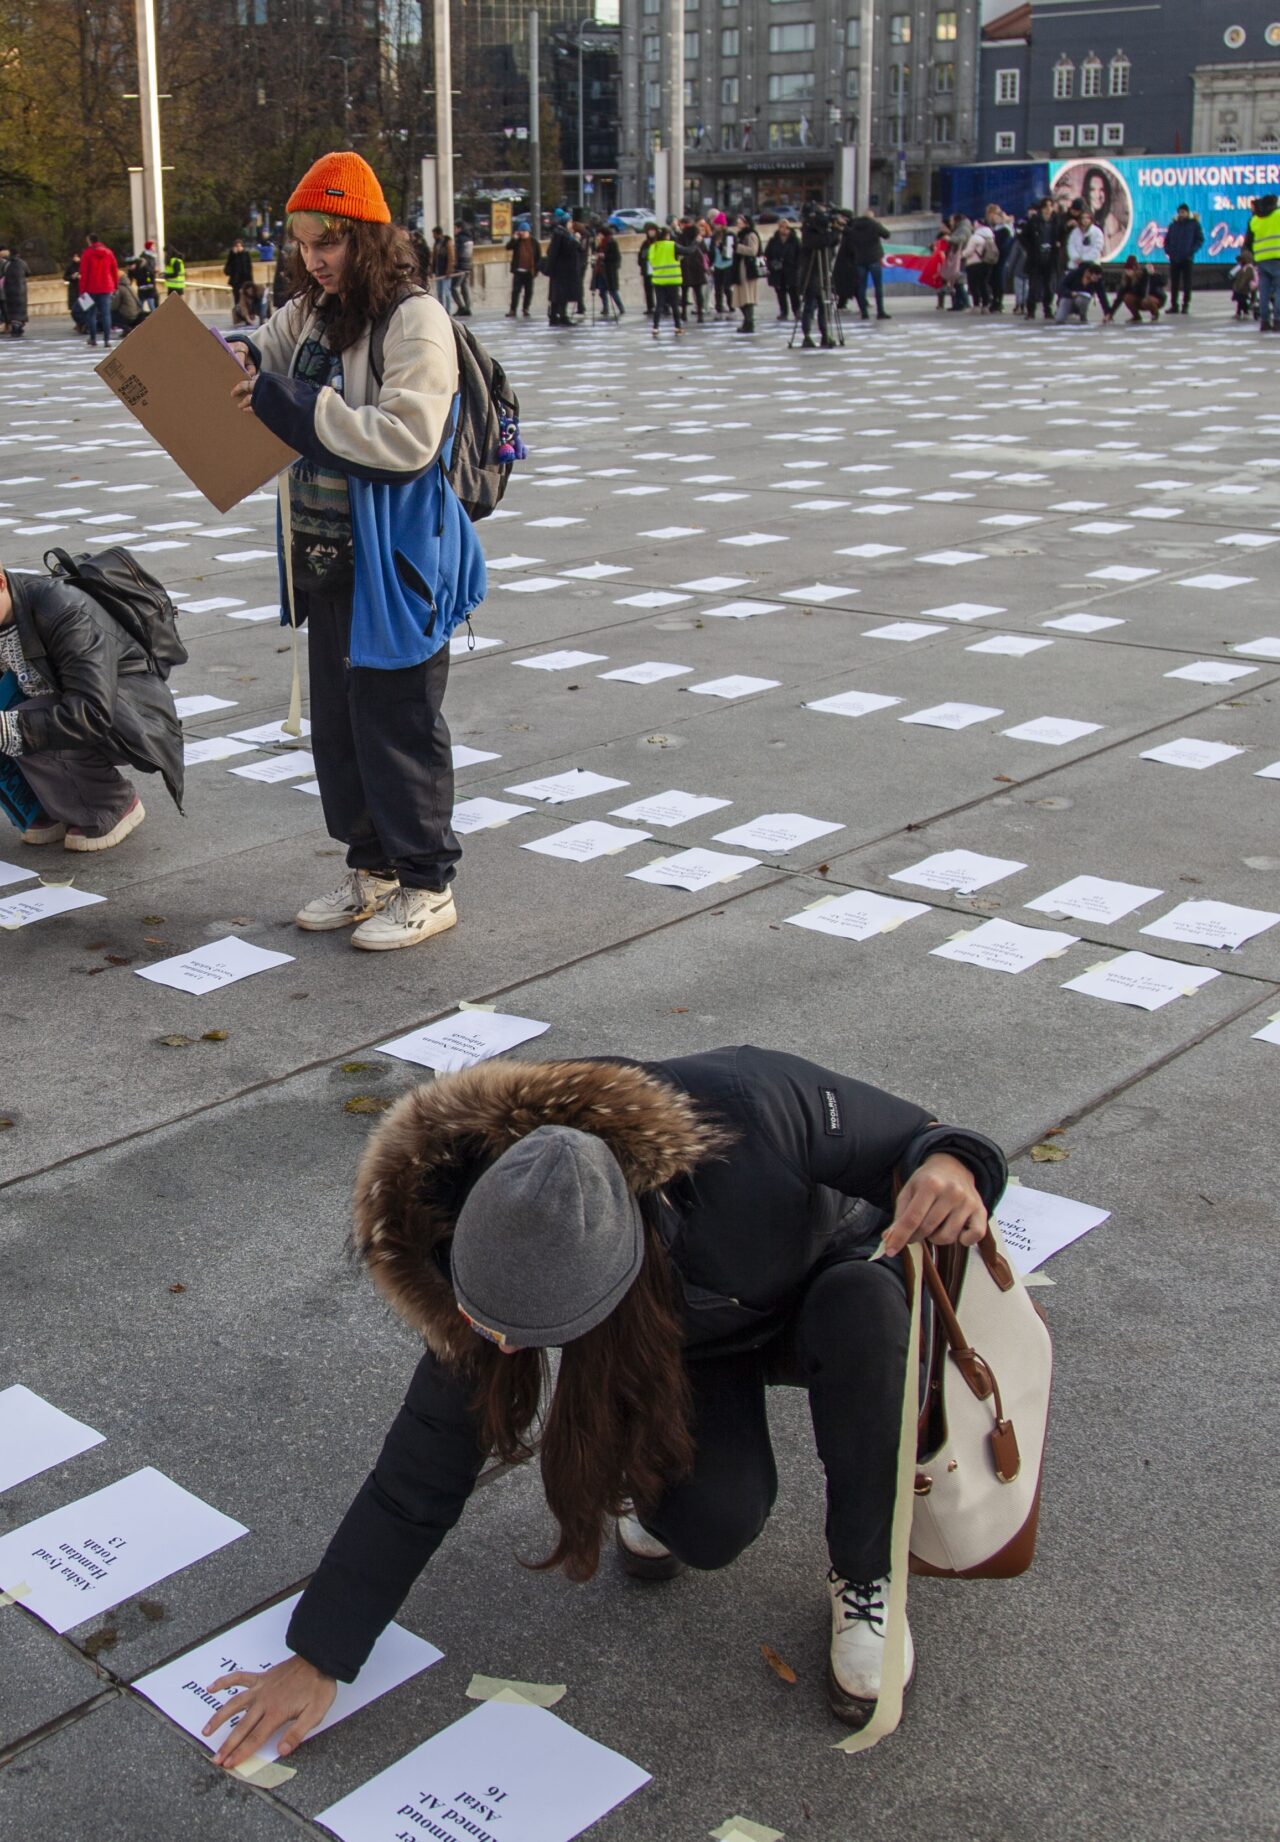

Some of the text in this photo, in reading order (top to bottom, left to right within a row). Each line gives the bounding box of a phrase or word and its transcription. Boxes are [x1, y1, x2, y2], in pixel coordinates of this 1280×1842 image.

[1138, 165, 1280, 187] HOOVIKONTSER
[1236, 195, 1260, 210] NO
[825, 1091, 837, 1130] WOOLRICH
[1004, 1239, 1036, 1251] Ahme
[83, 1539, 117, 1565] Totah
[108, 1537, 126, 1549] 13
[32, 1548, 96, 1591] Aisha Iyad
[59, 1543, 107, 1580] Hamdan
[419, 1791, 446, 1810] Al-
[483, 1786, 509, 1803] 16
[454, 1791, 502, 1822] Astal
